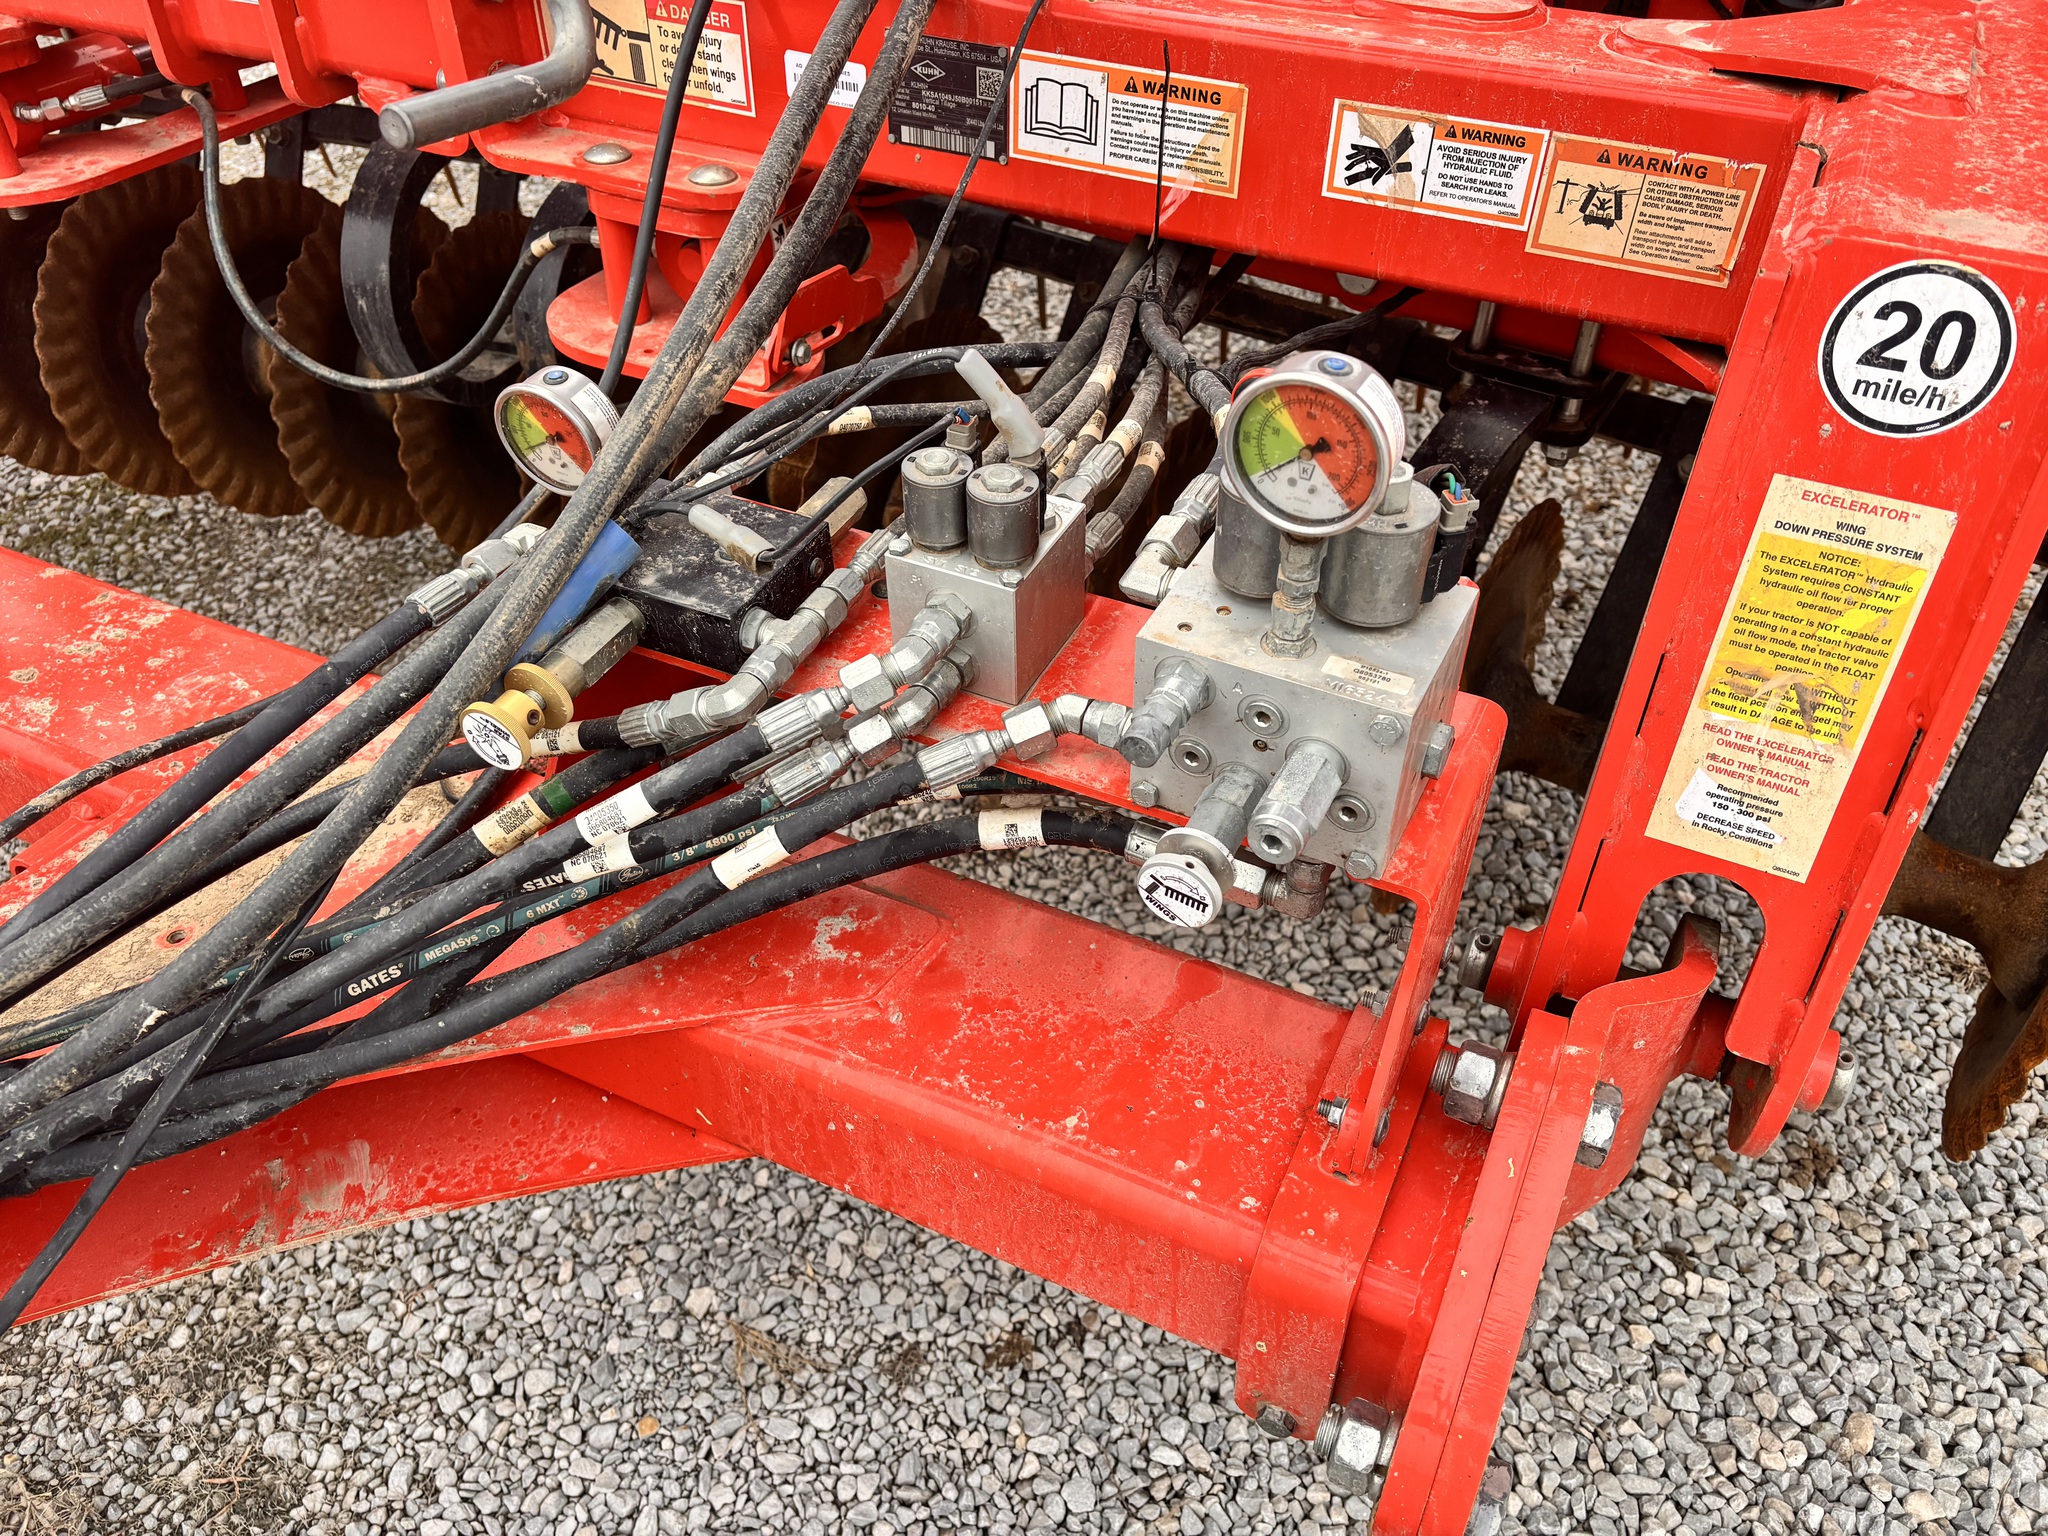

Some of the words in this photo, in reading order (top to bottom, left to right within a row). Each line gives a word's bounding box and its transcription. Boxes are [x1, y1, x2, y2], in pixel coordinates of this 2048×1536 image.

[656, 25, 669, 37] To
[659, 43, 669, 53] or
[696, 48, 722, 63] stand
[709, 66, 736, 84] wings
[917, 65, 939, 75] KUHN
[693, 77, 723, 93] unfold.
[1143, 80, 1222, 106] WARNING
[912, 101, 935, 111] 8010-40
[1462, 128, 1526, 148] WARNING
[1109, 151, 1132, 160] PROPER
[1436, 144, 1461, 154] AVOID
[1462, 148, 1497, 159] SERIOUS
[1498, 153, 1527, 164] INJURY
[1441, 153, 1464, 162] FROM
[1465, 156, 1506, 169] INJECTION
[1507, 163, 1519, 171] OF
[1443, 161, 1487, 174] HYDRAULIC
[1488, 168, 1514, 178] FLUID.
[1618, 152, 1709, 179] WARNING
[1440, 181, 1468, 190] SEARCH
[1469, 185, 1483, 193] FOR
[1484, 188, 1508, 197] LEAKS.
[1448, 174, 1463, 182] NOT
[1464, 176, 1478, 184] USE
[1478, 179, 1502, 188] HANDS
[1647, 180, 1677, 190] CONTACT
[1700, 188, 1725, 197] POWER
[1725, 192, 1740, 200] LINE
[1428, 189, 1448, 197] REFER
[1493, 200, 1516, 209] MANUAL
[1641, 200, 1664, 209] BODILY
[1665, 204, 1688, 213] INJURY
[1643, 194, 1665, 202] CAUSE
[1665, 197, 1695, 208] DAMAGE,
[1695, 202, 1723, 212] SERIOUS
[1655, 189, 1678, 197] OTHER
[1678, 192, 1723, 204] OBSTRUCTION
[1855, 300, 1977, 380] 20
[1852, 378, 1946, 411] mile/h
[1834, 520, 1867, 535] WING
[1773, 519, 1810, 535] DOWN
[1811, 528, 1874, 549] PRESSURE
[1875, 542, 1923, 560] SYSTEM
[1818, 551, 1861, 567] NOTICE:
[1758, 550, 1778, 561] The
[1864, 575, 1914, 595] Hydraulic
[1761, 564, 1798, 581] System
[1798, 573, 1841, 591] requires
[1842, 583, 1901, 603] CONSTANT
[1758, 577, 1804, 596] hydraulic
[1805, 588, 1819, 597] oil
[1819, 591, 1842, 603] flow
[1843, 597, 1858, 607] for
[1858, 602, 1893, 617] proper
[1794, 599, 1846, 619] operation.
[1739, 602, 1747, 610] If
[1747, 606, 1770, 618] your
[1771, 610, 1804, 624] tractor
[1805, 618, 1815, 627] is
[1816, 621, 1839, 633] NOT
[1839, 627, 1880, 645] capable
[1880, 637, 1892, 646] of
[1731, 613, 1778, 633] operating
[1779, 625, 1789, 633] in
[1798, 630, 1842, 646] constant
[1841, 640, 1890, 660] hydraulic
[1733, 626, 1746, 635] oil
[1747, 630, 1768, 641] flow
[1768, 635, 1799, 651] mode,
[1800, 643, 1817, 653] the
[1817, 647, 1850, 661] tractor
[1852, 656, 1879, 669] valve
[1728, 637, 1753, 649] must
[1754, 643, 1767, 653] be
[1767, 647, 1810, 666] operated
[1811, 658, 1822, 667] in
[1823, 661, 1840, 671] the
[1840, 665, 1875, 680] FLOAT
[1702, 722, 1732, 736] READ
[1733, 730, 1754, 742] THE
[1715, 737, 1764, 757] OWNER'S
[1766, 751, 1812, 770] MANUAL
[1705, 752, 1735, 766] READ
[1735, 760, 1758, 772] THE
[1759, 767, 1810, 787] TRACTOR
[1706, 763, 1755, 783] OWNER'S
[1755, 777, 1802, 796] MANUAL
[1704, 789, 1745, 807] operating
[1745, 802, 1783, 818] pressure
[1716, 783, 1779, 806] Recommended
[1711, 800, 1729, 810] 150
[1736, 808, 1754, 818] 300
[1754, 813, 1771, 824] psi
[590, 830, 602, 838] NC
[603, 816, 627, 832] 070621
[1696, 811, 1744, 830] DECREASE
[1744, 826, 1775, 840] SPEED
[1700, 822, 1727, 837] Rocky
[1728, 830, 1774, 849] Conditions
[705, 833, 735, 849] 4800
[739, 826, 756, 841] psi
[571, 858, 581, 867] NC
[583, 852, 607, 863] 070621
[526, 909, 534, 918] 6
[1146, 894, 1176, 922] WINGS
